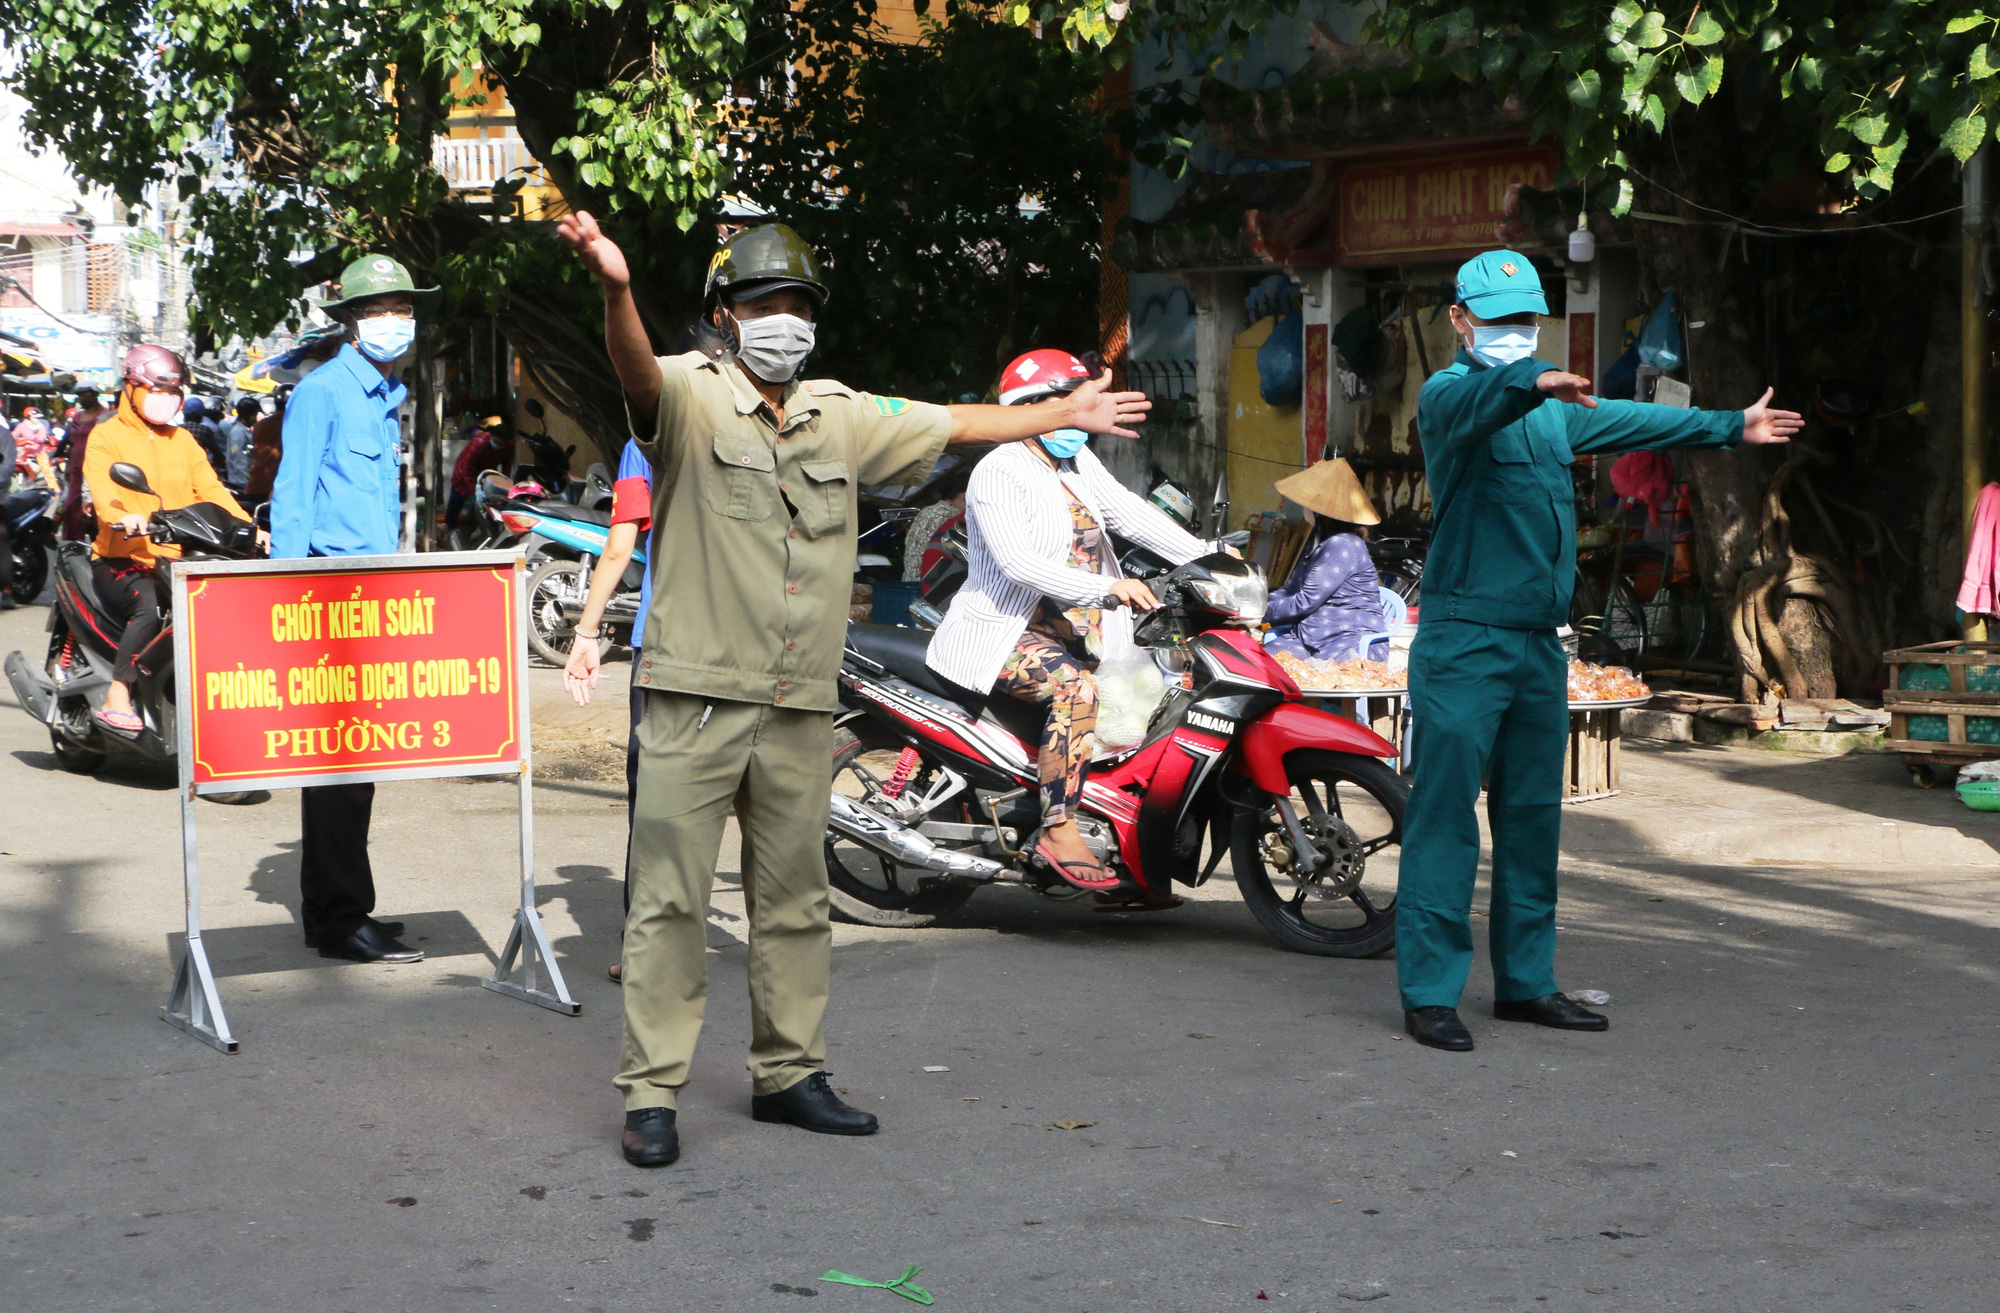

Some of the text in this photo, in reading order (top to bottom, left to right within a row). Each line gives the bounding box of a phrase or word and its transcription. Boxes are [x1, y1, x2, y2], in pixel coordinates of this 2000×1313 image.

[271, 585, 436, 642] CHỐT KIỂM SOÁT
[206, 654, 501, 711] PHÒNG, CHỐNG DỊCH COVID-19
[263, 716, 451, 759] PHƯỜNG 3
[1187, 709, 1235, 735] YAMAHA
